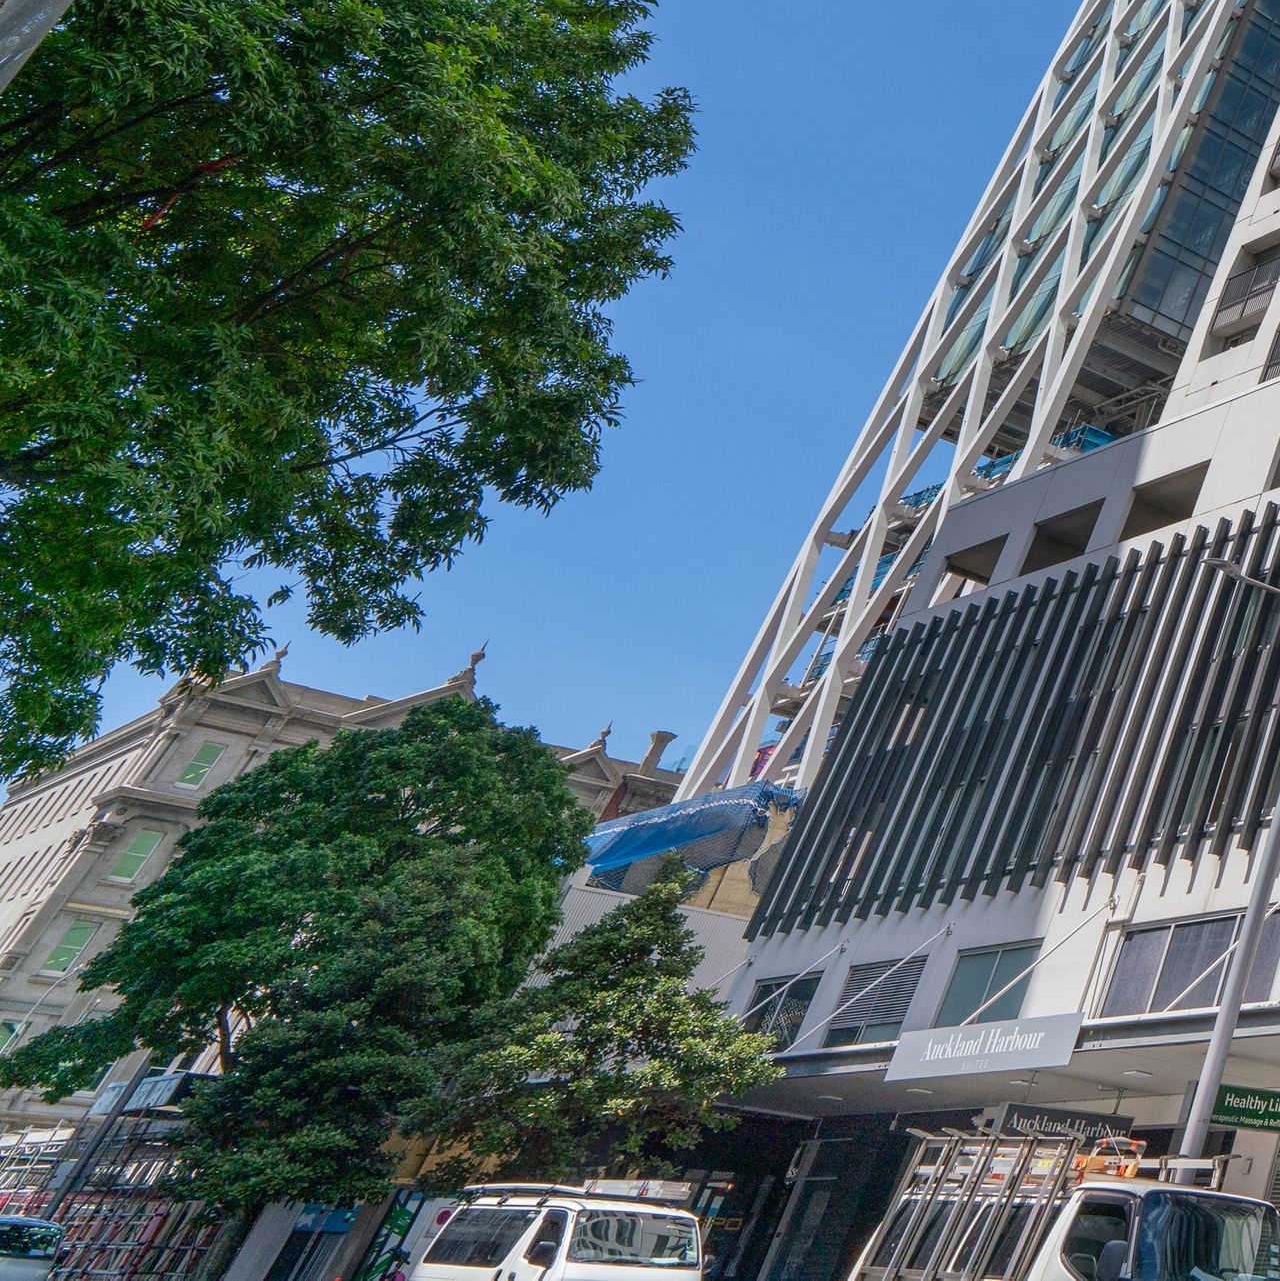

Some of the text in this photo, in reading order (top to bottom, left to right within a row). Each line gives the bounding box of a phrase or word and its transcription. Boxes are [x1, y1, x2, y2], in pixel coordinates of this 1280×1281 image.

[920, 1027, 1045, 1062] Auckland Harbour
[961, 1059, 989, 1070] SUITES
[1225, 1093, 1267, 1114] Healthy
[1211, 1114, 1239, 1123] erapeutic
[1240, 1115, 1264, 1127] Massage
